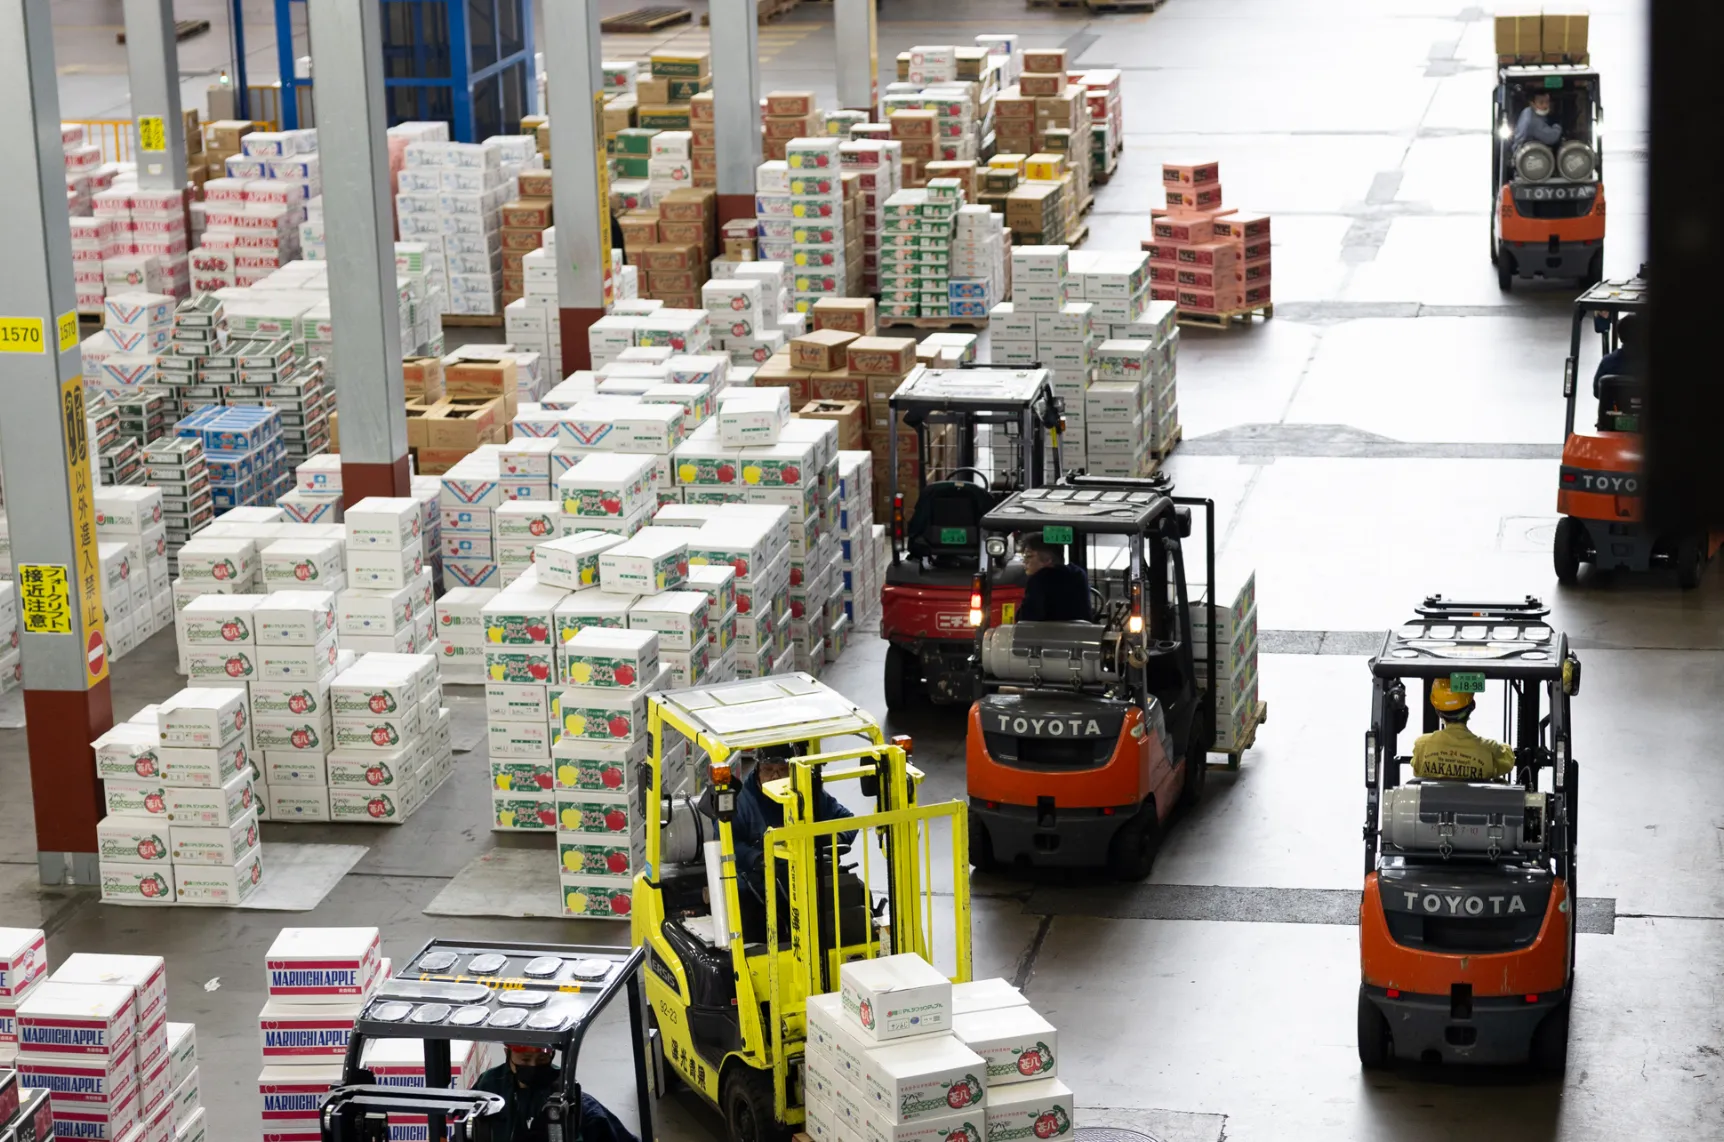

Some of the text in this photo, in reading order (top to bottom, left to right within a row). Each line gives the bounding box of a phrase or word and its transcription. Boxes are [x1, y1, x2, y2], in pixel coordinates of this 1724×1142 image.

[1524, 187, 1587, 199] TOYOTA
[2, 327, 40, 342] 1570
[60, 320, 76, 341] 1570
[76, 468, 98, 627] 以外進入禁止
[24, 569, 47, 628] 接近注意
[43, 568, 64, 629] フォークリフト
[998, 714, 1101, 736] TOYOTA
[1424, 760, 1483, 778] NAKAMURA
[1404, 891, 1526, 914] TOYOTA
[652, 959, 675, 987] ERSIS
